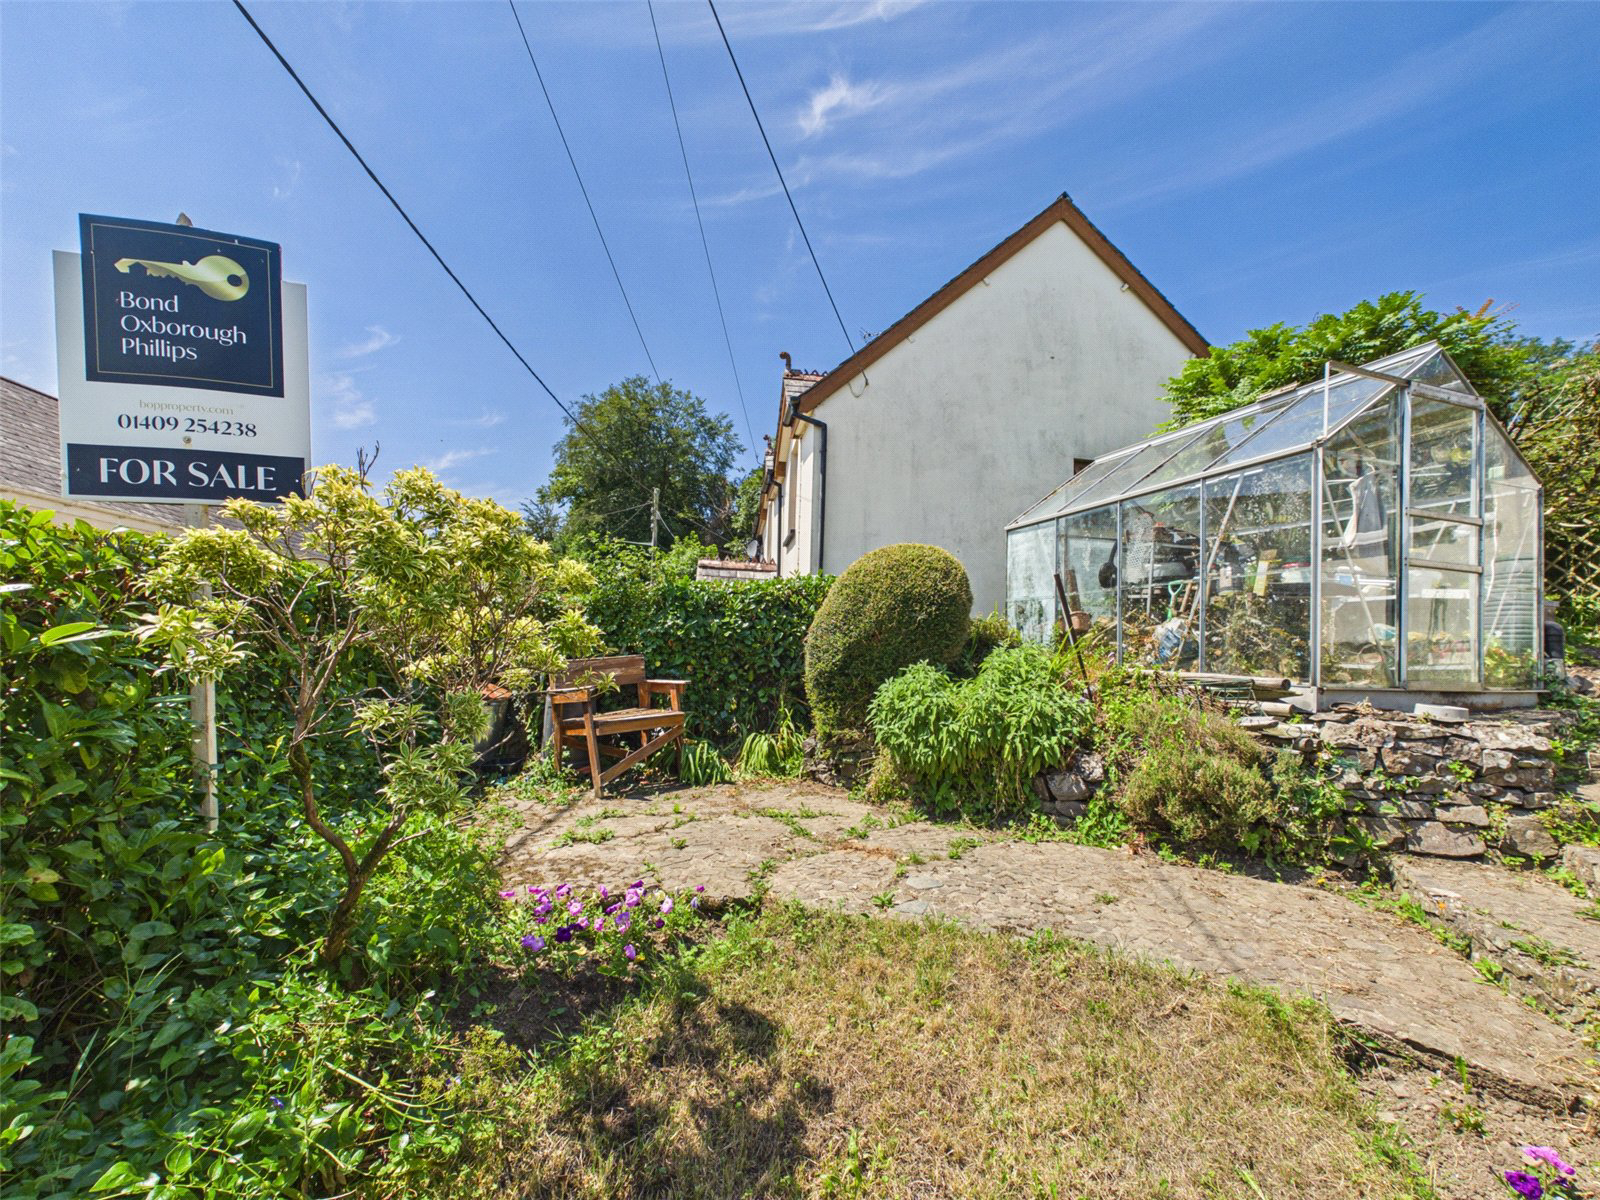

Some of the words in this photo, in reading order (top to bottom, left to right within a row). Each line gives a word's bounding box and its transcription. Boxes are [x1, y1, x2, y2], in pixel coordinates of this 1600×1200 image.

[119, 291, 179, 313] Bond
[120, 314, 247, 347] Oxborough
[121, 337, 198, 363] Phillips
[139, 399, 234, 416] bopproperty.com
[117, 413, 179, 431] 01409
[185, 417, 257, 438] 254238
[99, 457, 177, 487] FOR
[188, 461, 277, 492] SALE
